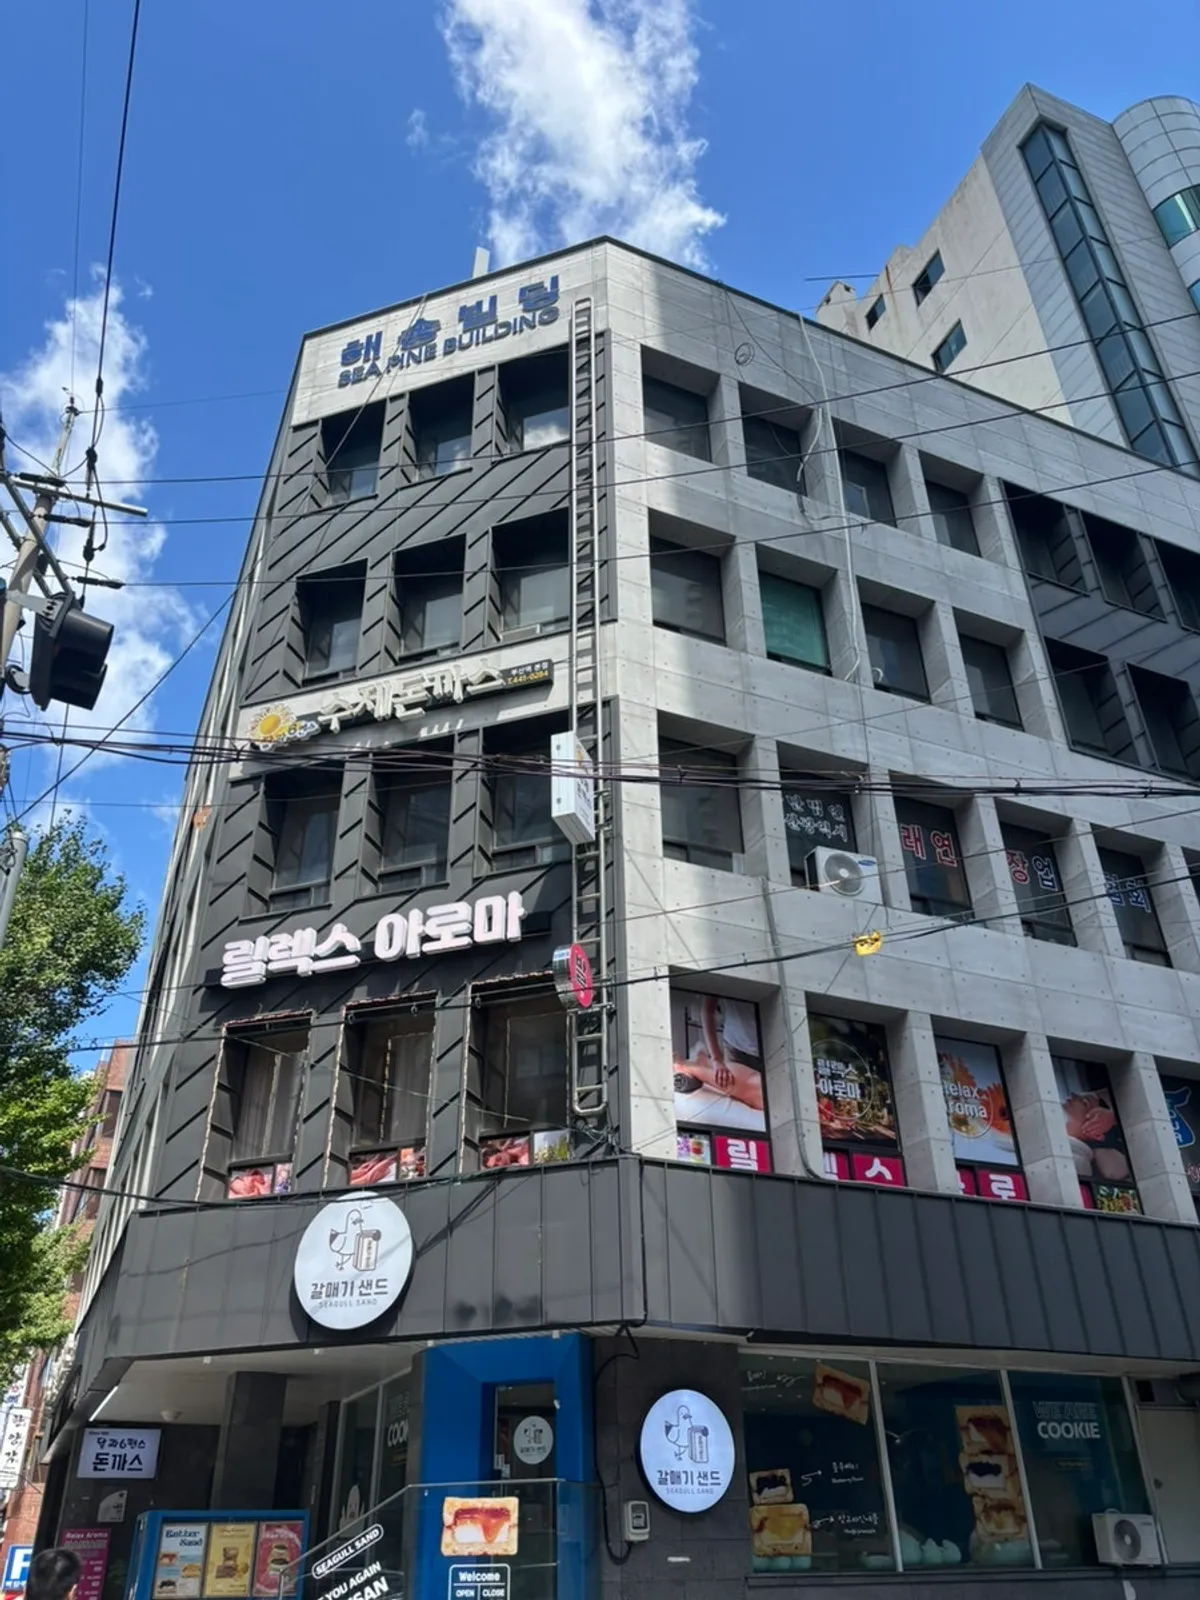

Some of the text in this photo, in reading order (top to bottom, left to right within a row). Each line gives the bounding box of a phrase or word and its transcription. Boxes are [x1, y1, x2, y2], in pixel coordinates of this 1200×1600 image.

[340, 274, 559, 367] 해송빌딩
[338, 305, 560, 388] SEA PINE BUILDING
[220, 890, 526, 989] 릴렉스 아로마
[820, 1078, 861, 1101] 아로마
[948, 1101, 988, 1119] roma
[311, 1278, 388, 1300] 갈매기 샌드
[319, 1299, 378, 1309] SEAGULL SAND
[1036, 1421, 1102, 1439] COOKIE
[92, 1452, 143, 1472] 돈까스
[657, 1470, 722, 1487] 갈매기 샌드
[666, 1487, 715, 1495] SEAGULL SAND
[315, 1529, 380, 1575] SEAGULL SAND
[325, 1561, 382, 1599] YOU AGAIN
[459, 1571, 500, 1581] Welcome
[456, 1588, 505, 1597] OPEN CLOSE
